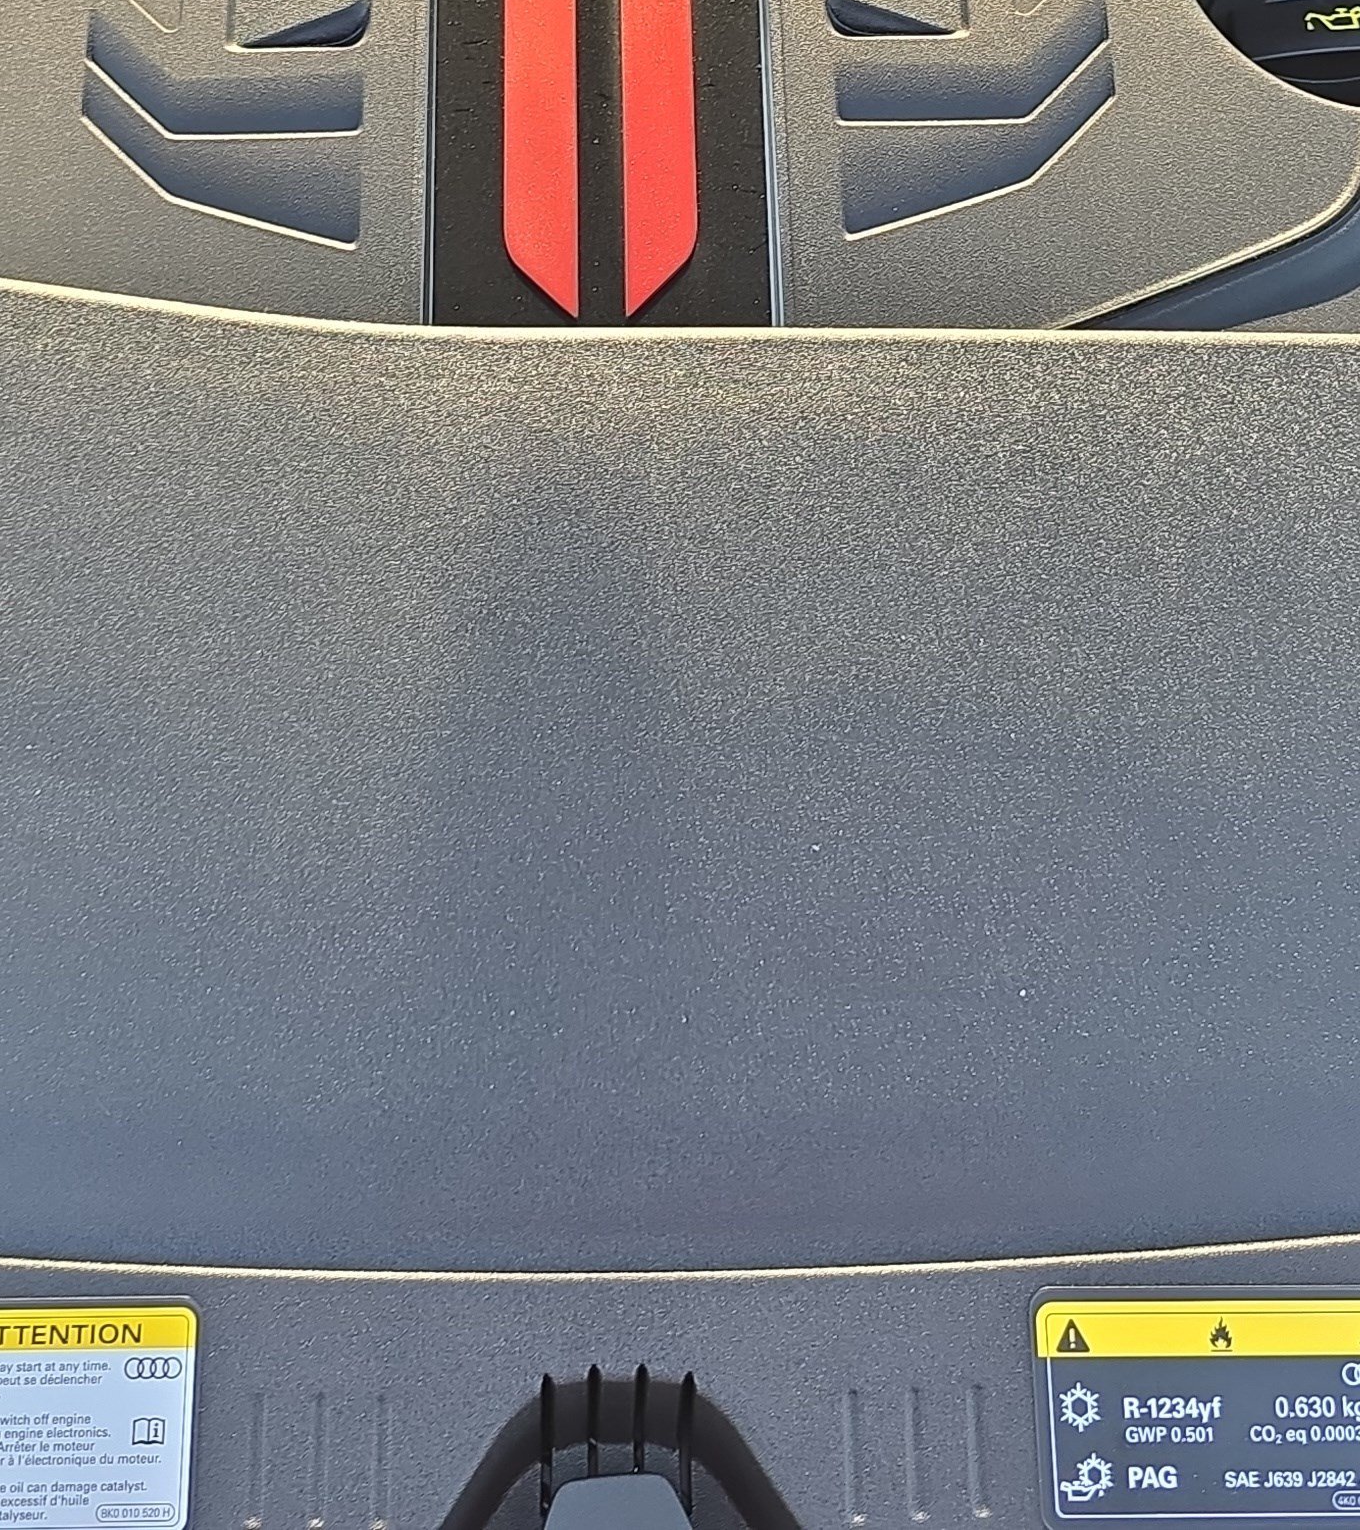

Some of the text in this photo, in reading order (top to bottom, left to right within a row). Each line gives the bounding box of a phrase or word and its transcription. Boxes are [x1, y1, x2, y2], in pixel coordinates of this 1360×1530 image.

[17, 1362, 42, 1372] start
[45, 1362, 56, 1372] at
[59, 1363, 80, 1374] any
[82, 1360, 112, 1371] time.
[24, 1377, 36, 1385] se
[40, 1374, 102, 1385] déclencher
[1123, 1396, 1222, 1423] R-1234yf
[1274, 1396, 1336, 1418] 0.630
[33, 1414, 50, 1425] off
[52, 1415, 91, 1427] engine
[4, 1429, 43, 1441] engine
[46, 1427, 112, 1438] electronics.
[1125, 1426, 1214, 1443] GWP 0.501
[1285, 1428, 1307, 1444] eq
[39, 1441, 50, 1451] le
[53, 1442, 96, 1451] moteur
[8, 1454, 15, 1465] à
[99, 1453, 114, 1464] du
[117, 1454, 162, 1464] moteur.
[1128, 1466, 1178, 1489] PAG
[1224, 1471, 1260, 1488] SAE
[1264, 1471, 1303, 1488] J639
[1307, 1470, 1356, 1487] J2842
[9, 1482, 24, 1493] oil
[26, 1483, 48, 1493] can
[51, 1481, 97, 1494] damage
[0, 1495, 47, 1506] excessif
[122, 1508, 140, 1518] 010
[142, 1508, 160, 1518] 520
[162, 1507, 171, 1517] H
